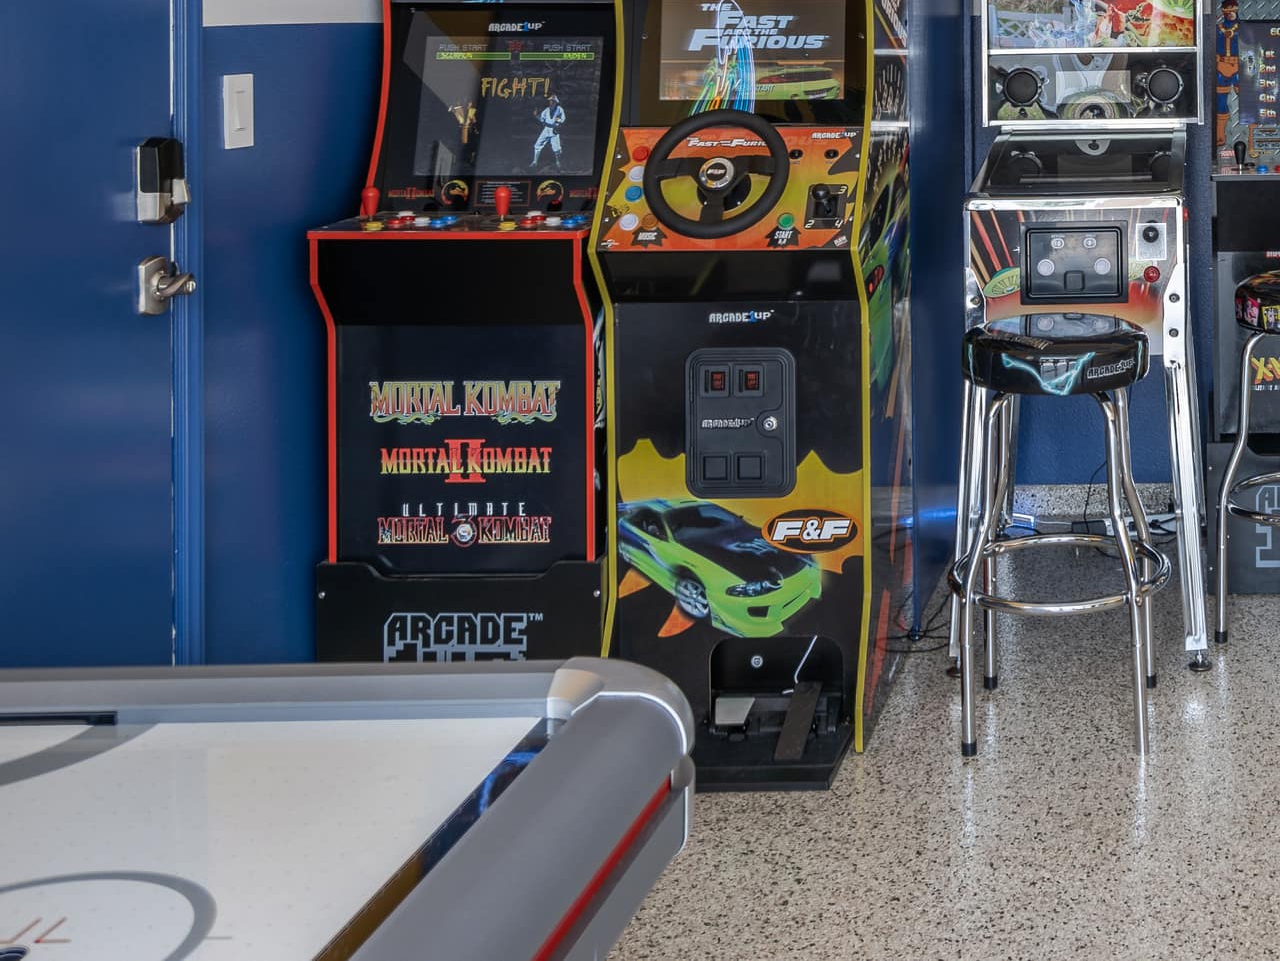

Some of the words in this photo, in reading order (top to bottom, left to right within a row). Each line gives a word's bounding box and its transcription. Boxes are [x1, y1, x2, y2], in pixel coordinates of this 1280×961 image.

[701, 3, 732, 11] THE
[718, 11, 794, 28] FAST
[687, 29, 825, 51] FURIOUS
[1260, 64, 1276, 72] 2nd
[481, 77, 551, 99] FIGHT!
[1260, 79, 1276, 87] 3rd
[1259, 94, 1276, 102] 4th
[1260, 109, 1276, 117] 5th
[687, 137, 719, 147] FAST
[731, 139, 767, 147] FURIO
[838, 186, 848, 194] 3
[804, 219, 815, 228] 2
[834, 219, 844, 228] 4
[774, 230, 793, 239] START
[369, 381, 461, 417] MORTAL
[463, 380, 561, 417] KOMBAT
[380, 447, 465, 474] MORTAL
[467, 447, 552, 474] KOMBAT
[402, 502, 526, 517] ULTIMATE
[377, 517, 449, 544] MORTAL
[478, 517, 552, 544] KOMBAT
[772, 519, 851, 542] F&F
[384, 612, 528, 648] ARCADE
